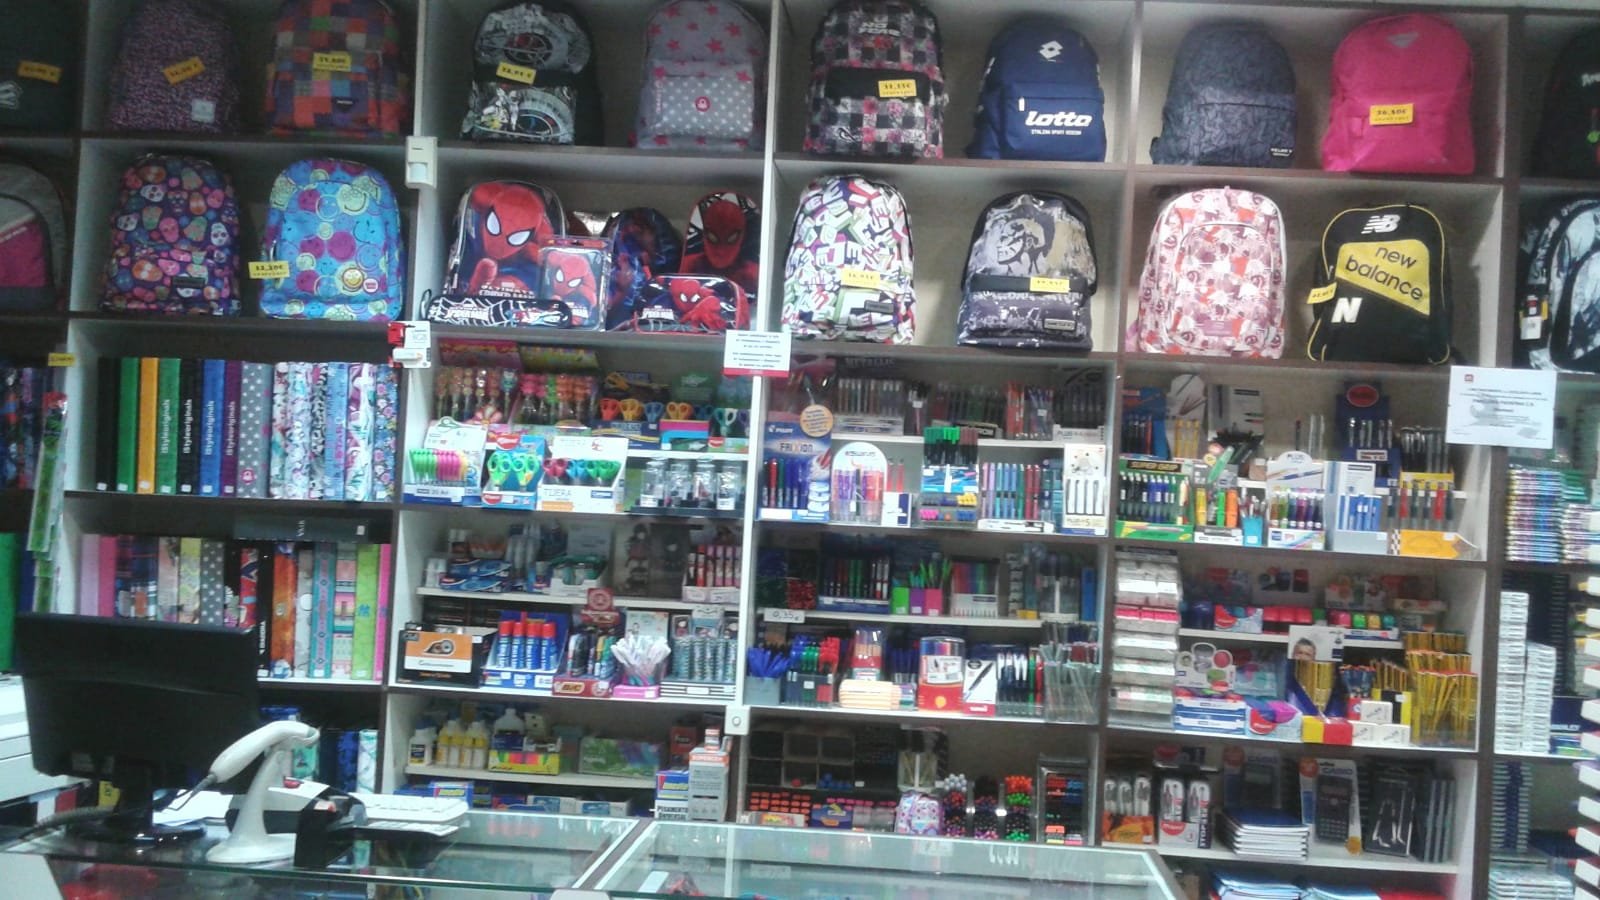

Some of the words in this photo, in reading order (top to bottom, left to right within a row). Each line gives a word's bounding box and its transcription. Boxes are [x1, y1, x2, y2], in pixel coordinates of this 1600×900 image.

[1375, 246, 1417, 269] new
[1345, 255, 1424, 301] balance
[1331, 297, 1363, 323] N
